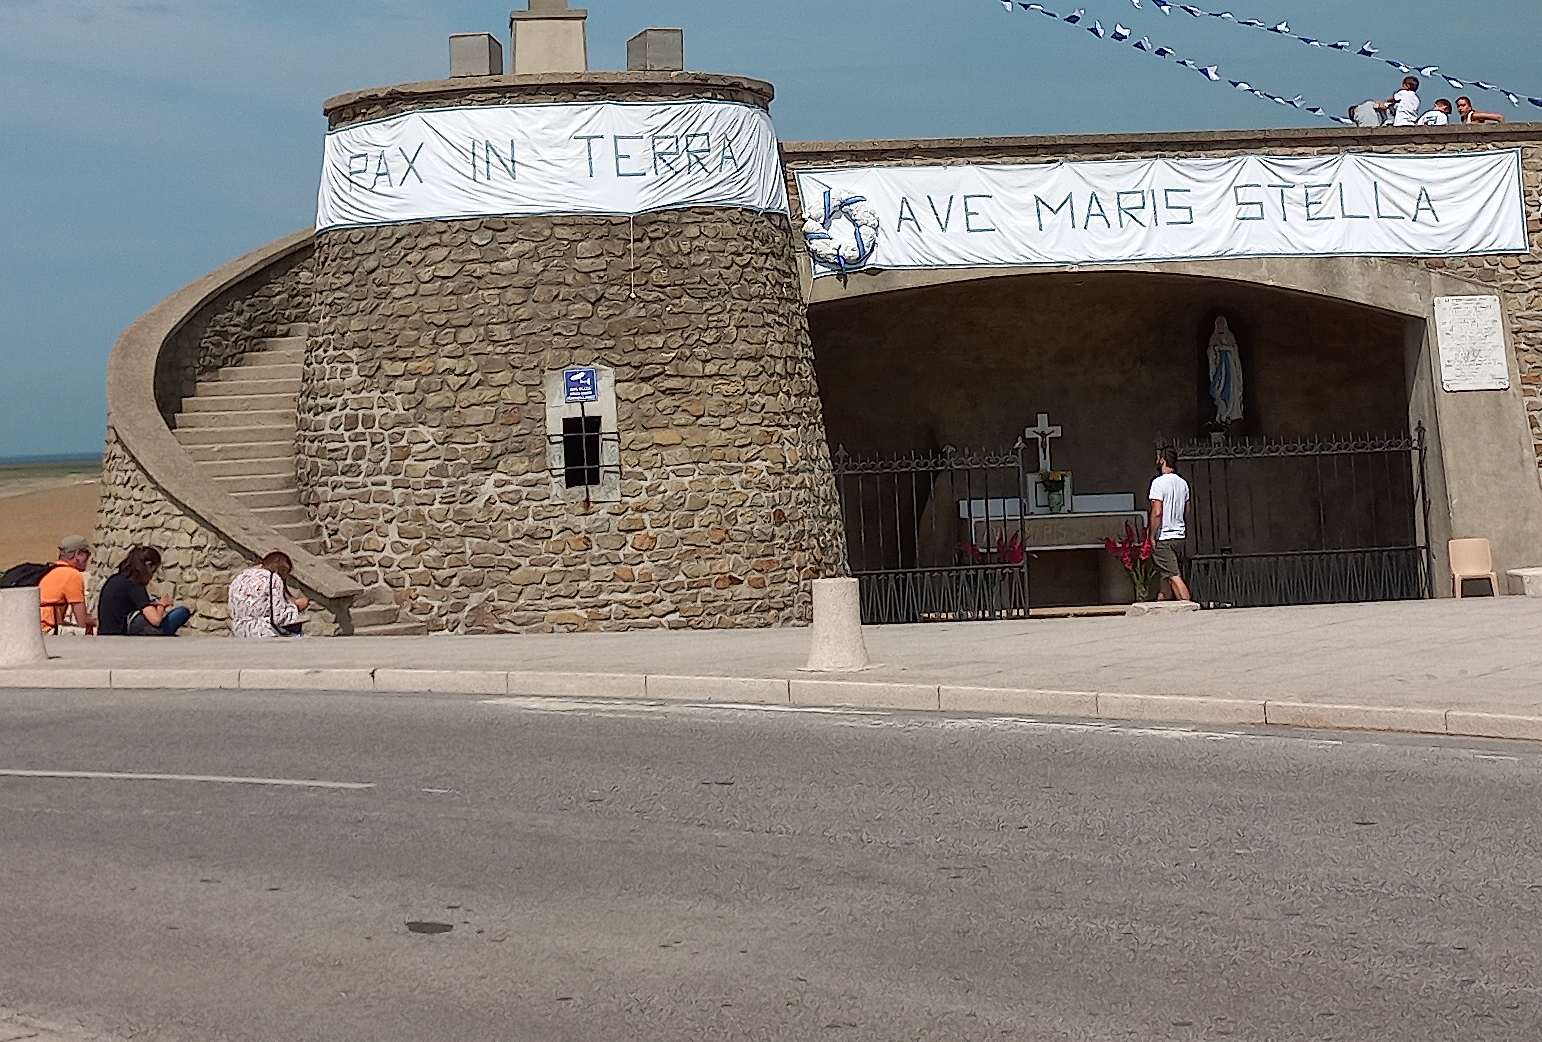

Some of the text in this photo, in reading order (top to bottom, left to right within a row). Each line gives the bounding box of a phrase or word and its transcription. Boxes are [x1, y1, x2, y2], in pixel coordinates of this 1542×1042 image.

[348, 131, 740, 193] PAX IN TERRA
[896, 181, 1440, 233] AVE MARIS STELLA
